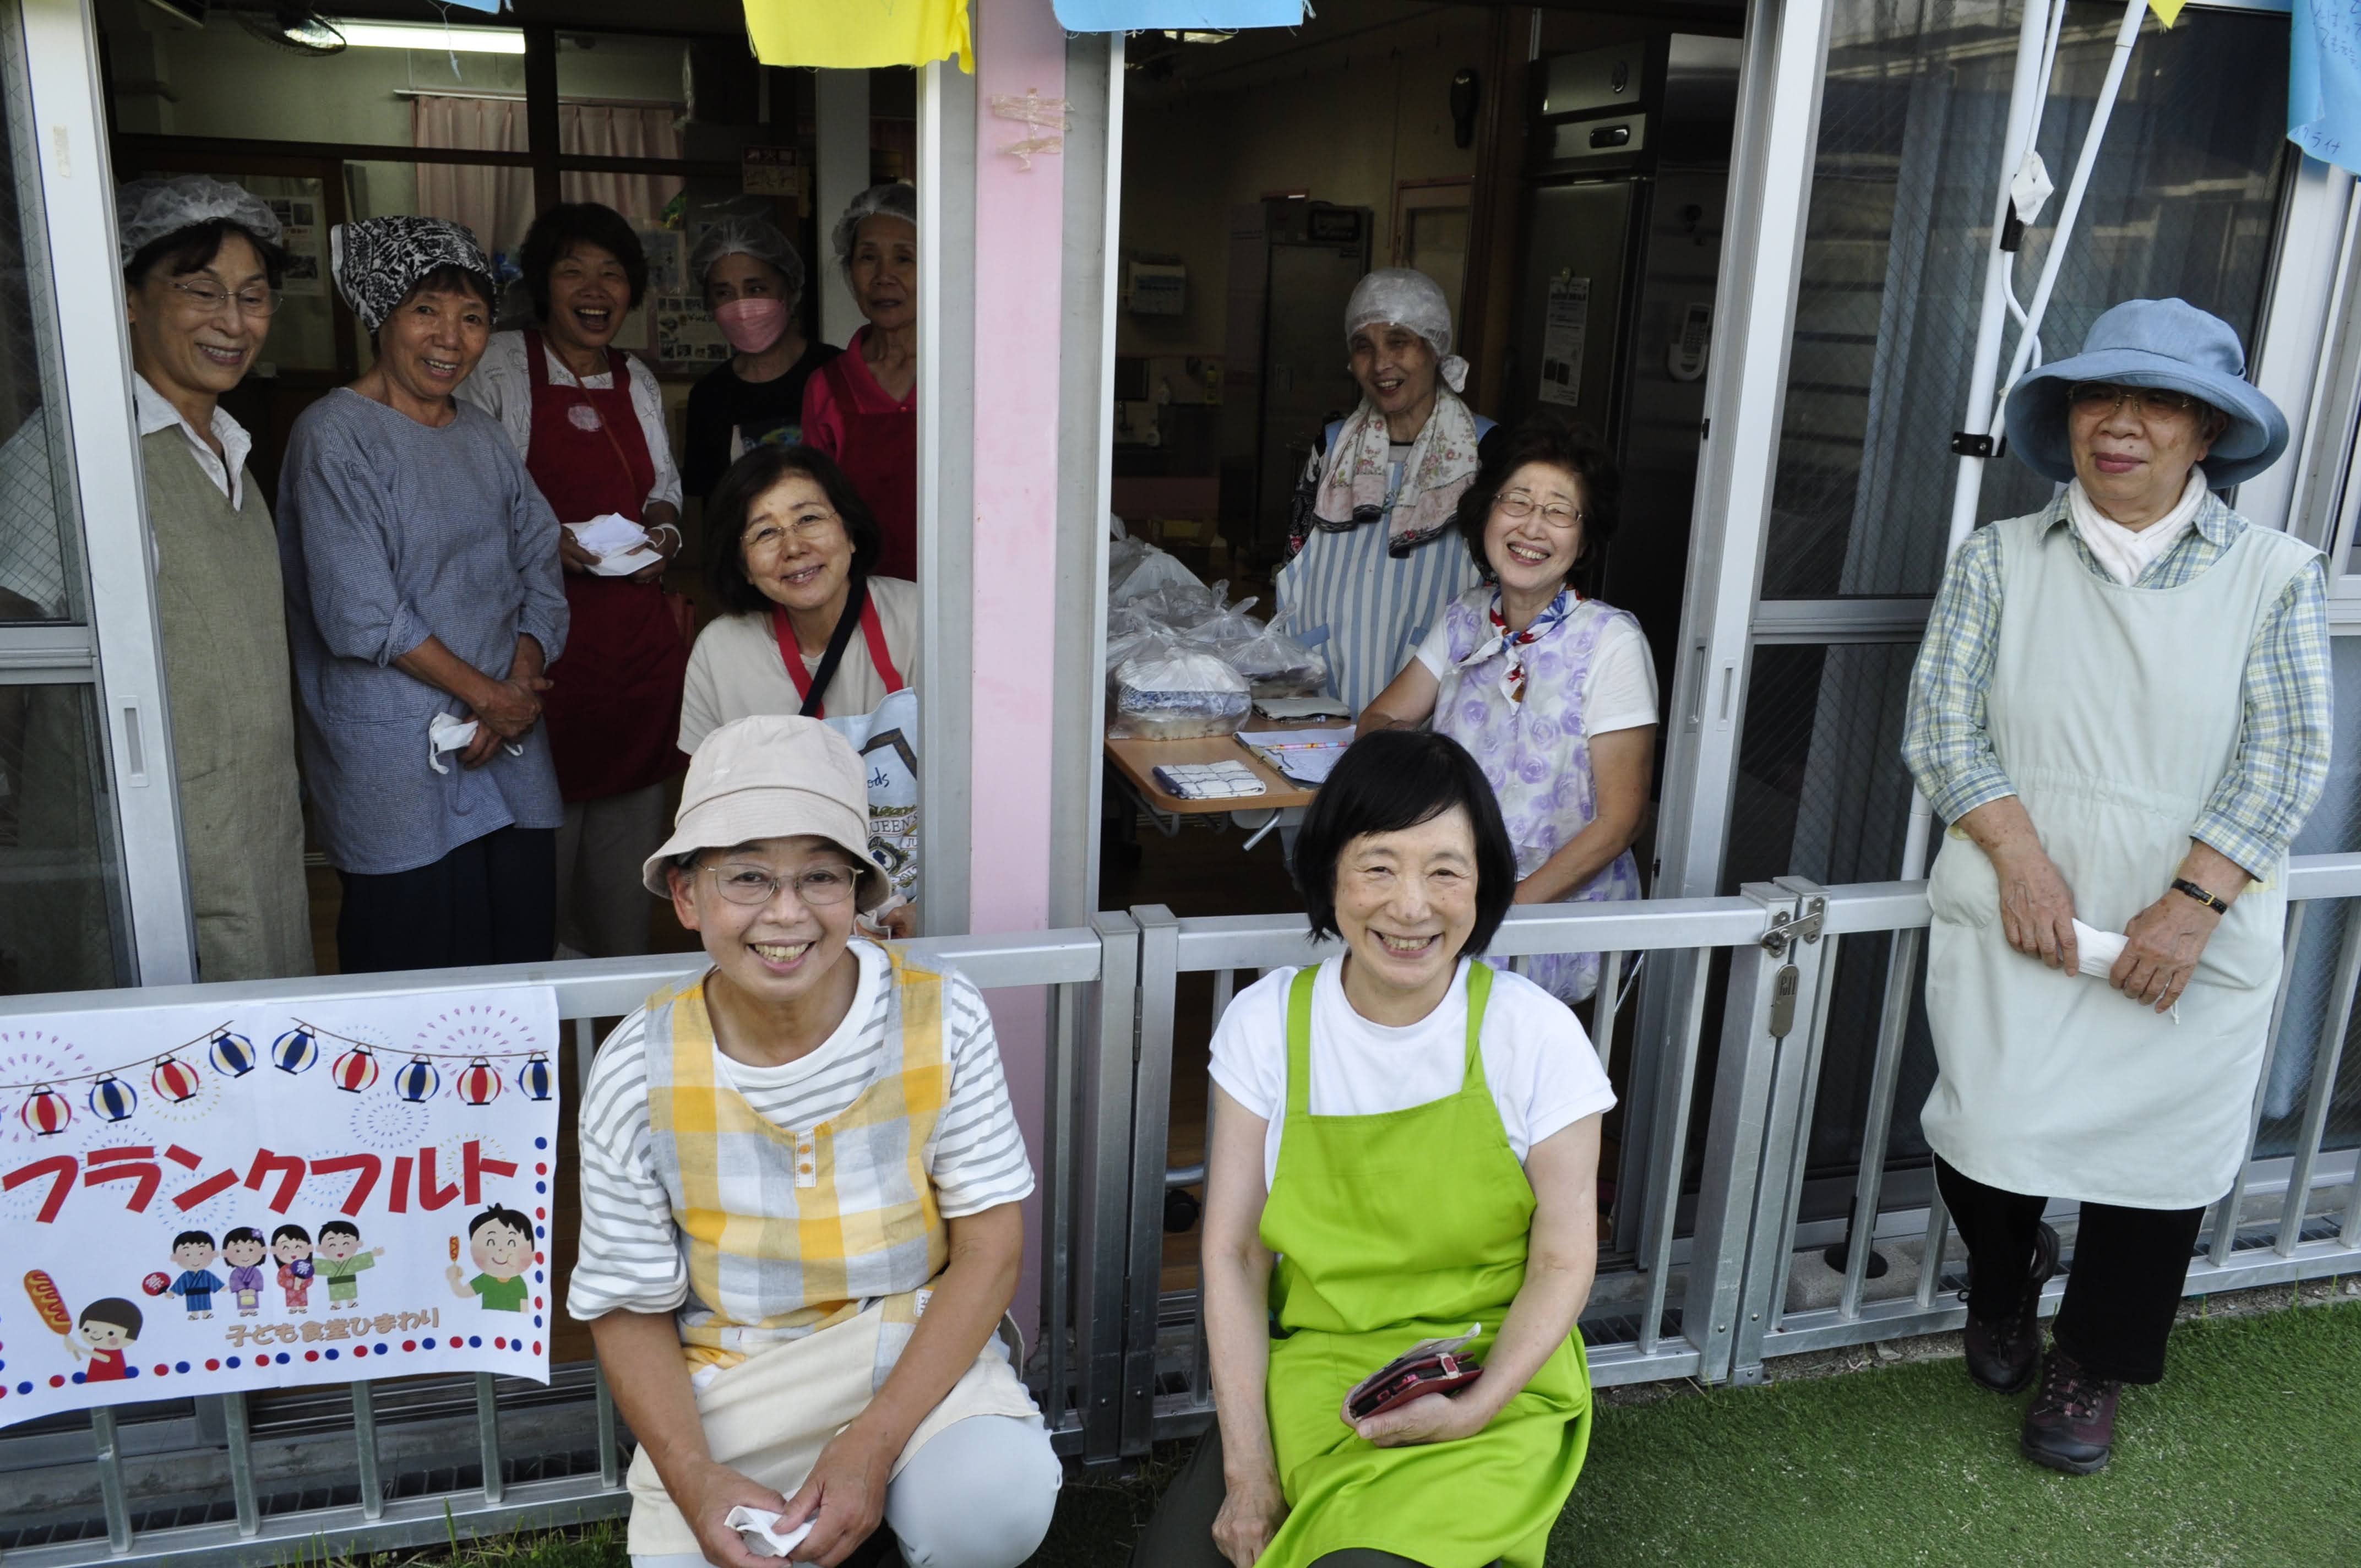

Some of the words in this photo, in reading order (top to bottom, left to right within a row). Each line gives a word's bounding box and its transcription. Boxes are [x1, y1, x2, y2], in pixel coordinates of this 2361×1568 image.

[867, 767, 890, 788] ods
[869, 812, 917, 832] UEEN'S
[907, 838, 917, 847] JU
[2, 1140, 518, 1224] フランクフルト
[225, 1307, 439, 1347] 子ども食堂ひまわり
